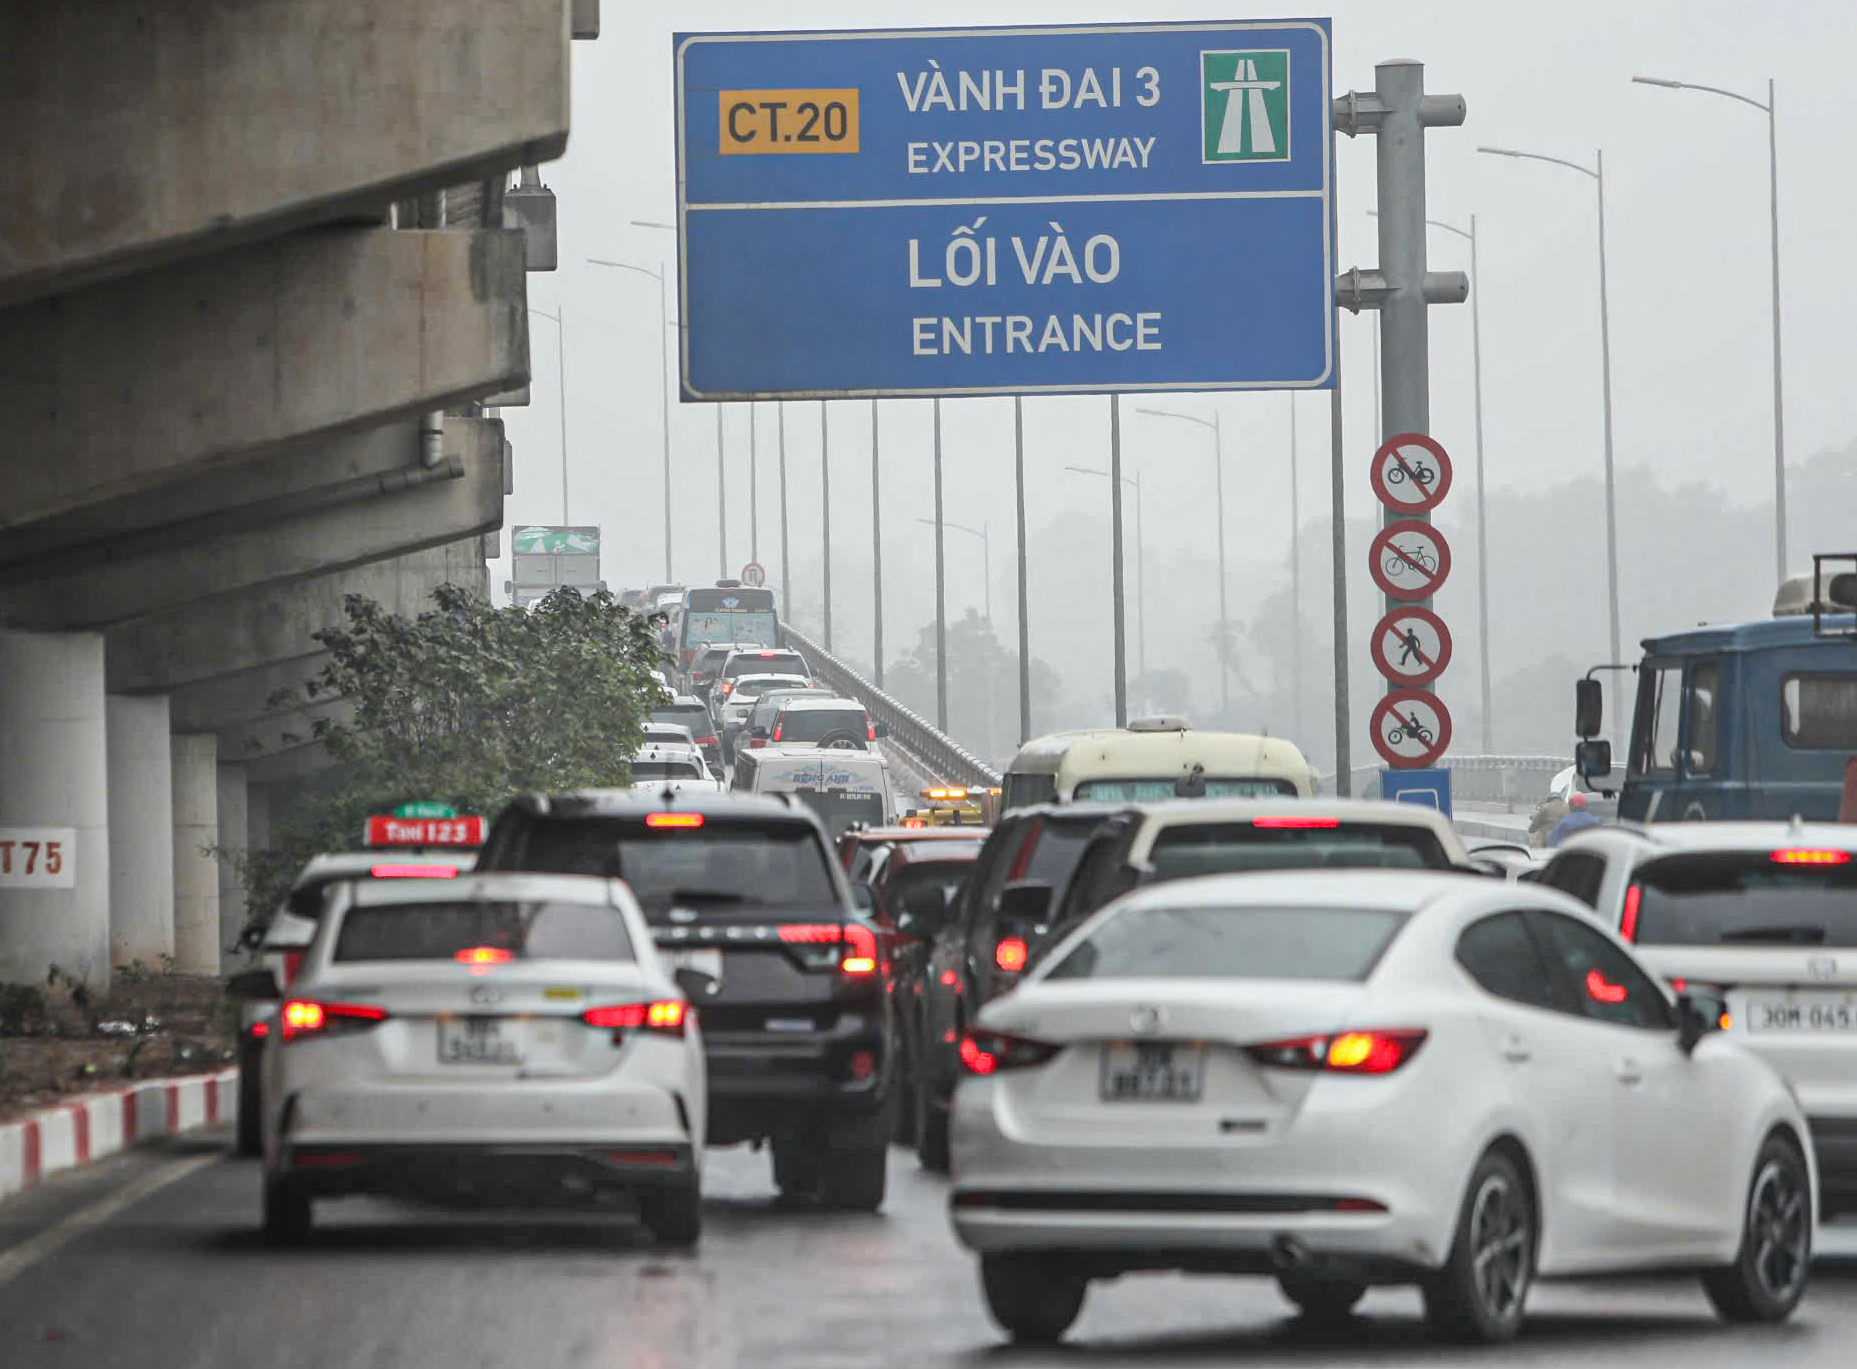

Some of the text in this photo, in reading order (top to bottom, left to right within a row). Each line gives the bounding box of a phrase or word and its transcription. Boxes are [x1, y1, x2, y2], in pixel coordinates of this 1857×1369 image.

[897, 59, 1161, 112] VÀNH ĐAI 3
[727, 101, 849, 143] CT.20
[907, 136, 1157, 174] EXPRESSWAY
[908, 216, 1120, 288] LỐI VÀO
[912, 312, 1162, 356] ENTRANCE
[427, 821, 467, 842] 123
